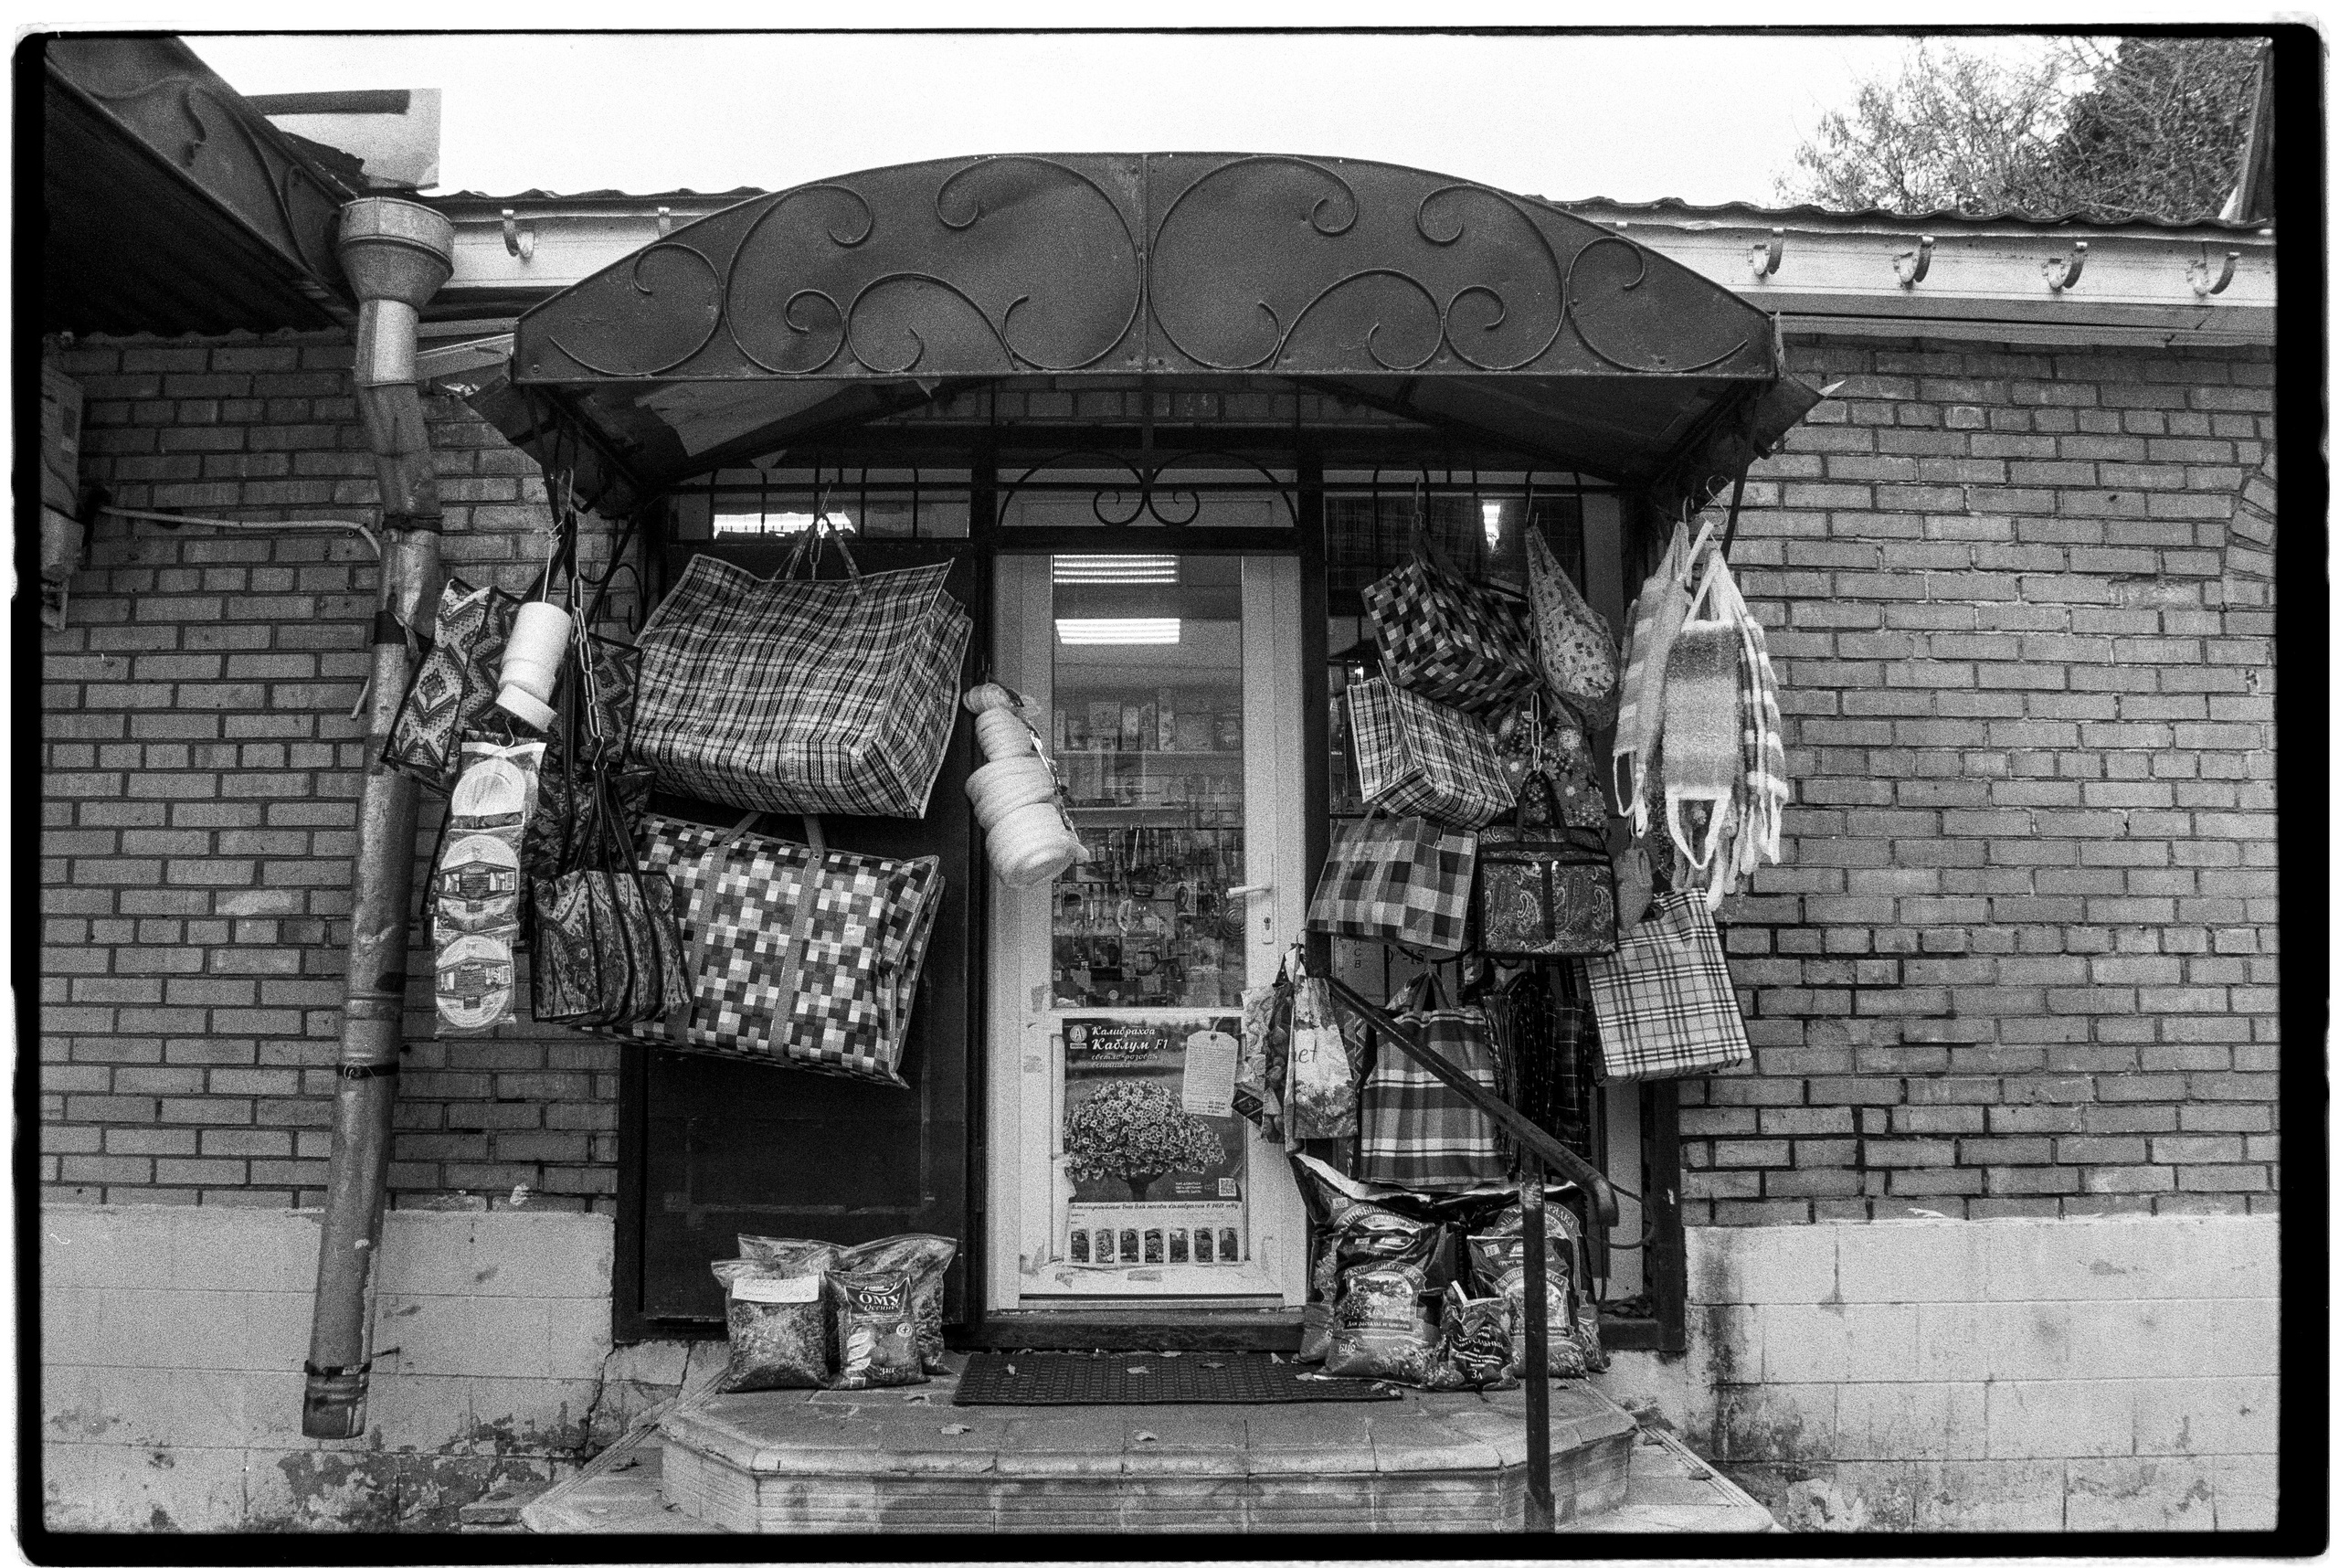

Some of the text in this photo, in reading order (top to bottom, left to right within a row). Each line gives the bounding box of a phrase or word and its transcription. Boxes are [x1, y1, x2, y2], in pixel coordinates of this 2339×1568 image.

[1091, 1025, 1156, 1038] Калибрахоа
[1091, 1037, 1149, 1053] Каблум
[1154, 1039, 1169, 1050] F1
[859, 1293, 901, 1307] ОМУ
